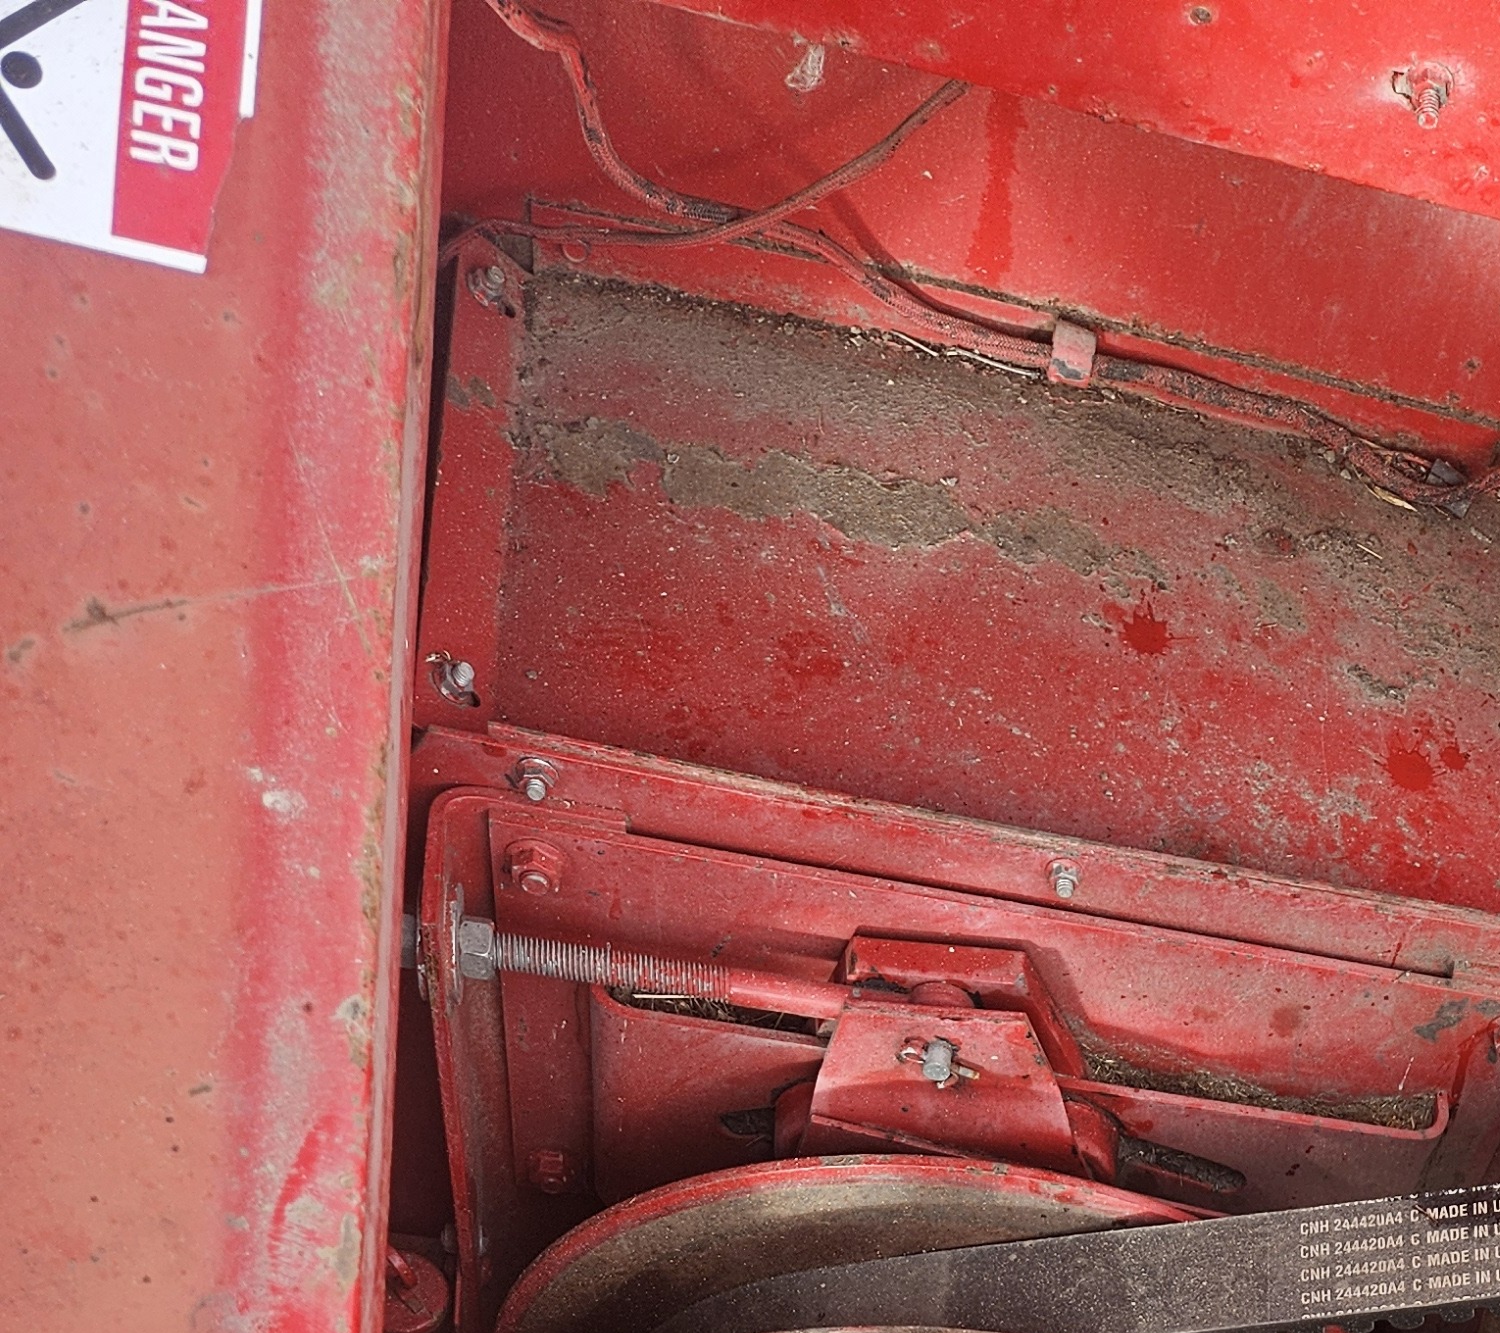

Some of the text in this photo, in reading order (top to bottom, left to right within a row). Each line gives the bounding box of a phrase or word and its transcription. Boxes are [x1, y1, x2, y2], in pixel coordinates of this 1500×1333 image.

[129, 0, 208, 171] ANGER
[1300, 1219, 1329, 1235] CNH
[1426, 1203, 1468, 1219] MADE
[1472, 1201, 1488, 1215] IN
[1300, 1242, 1330, 1259] CNH
[1426, 1227, 1469, 1243] MADE
[1473, 1224, 1489, 1238] IN
[1301, 1266, 1330, 1281] CNH
[1427, 1250, 1470, 1267] MADE
[1474, 1247, 1490, 1261] IN
[1301, 1289, 1331, 1304] CNH
[1428, 1273, 1471, 1289] MADE
[1475, 1270, 1491, 1284] IN
